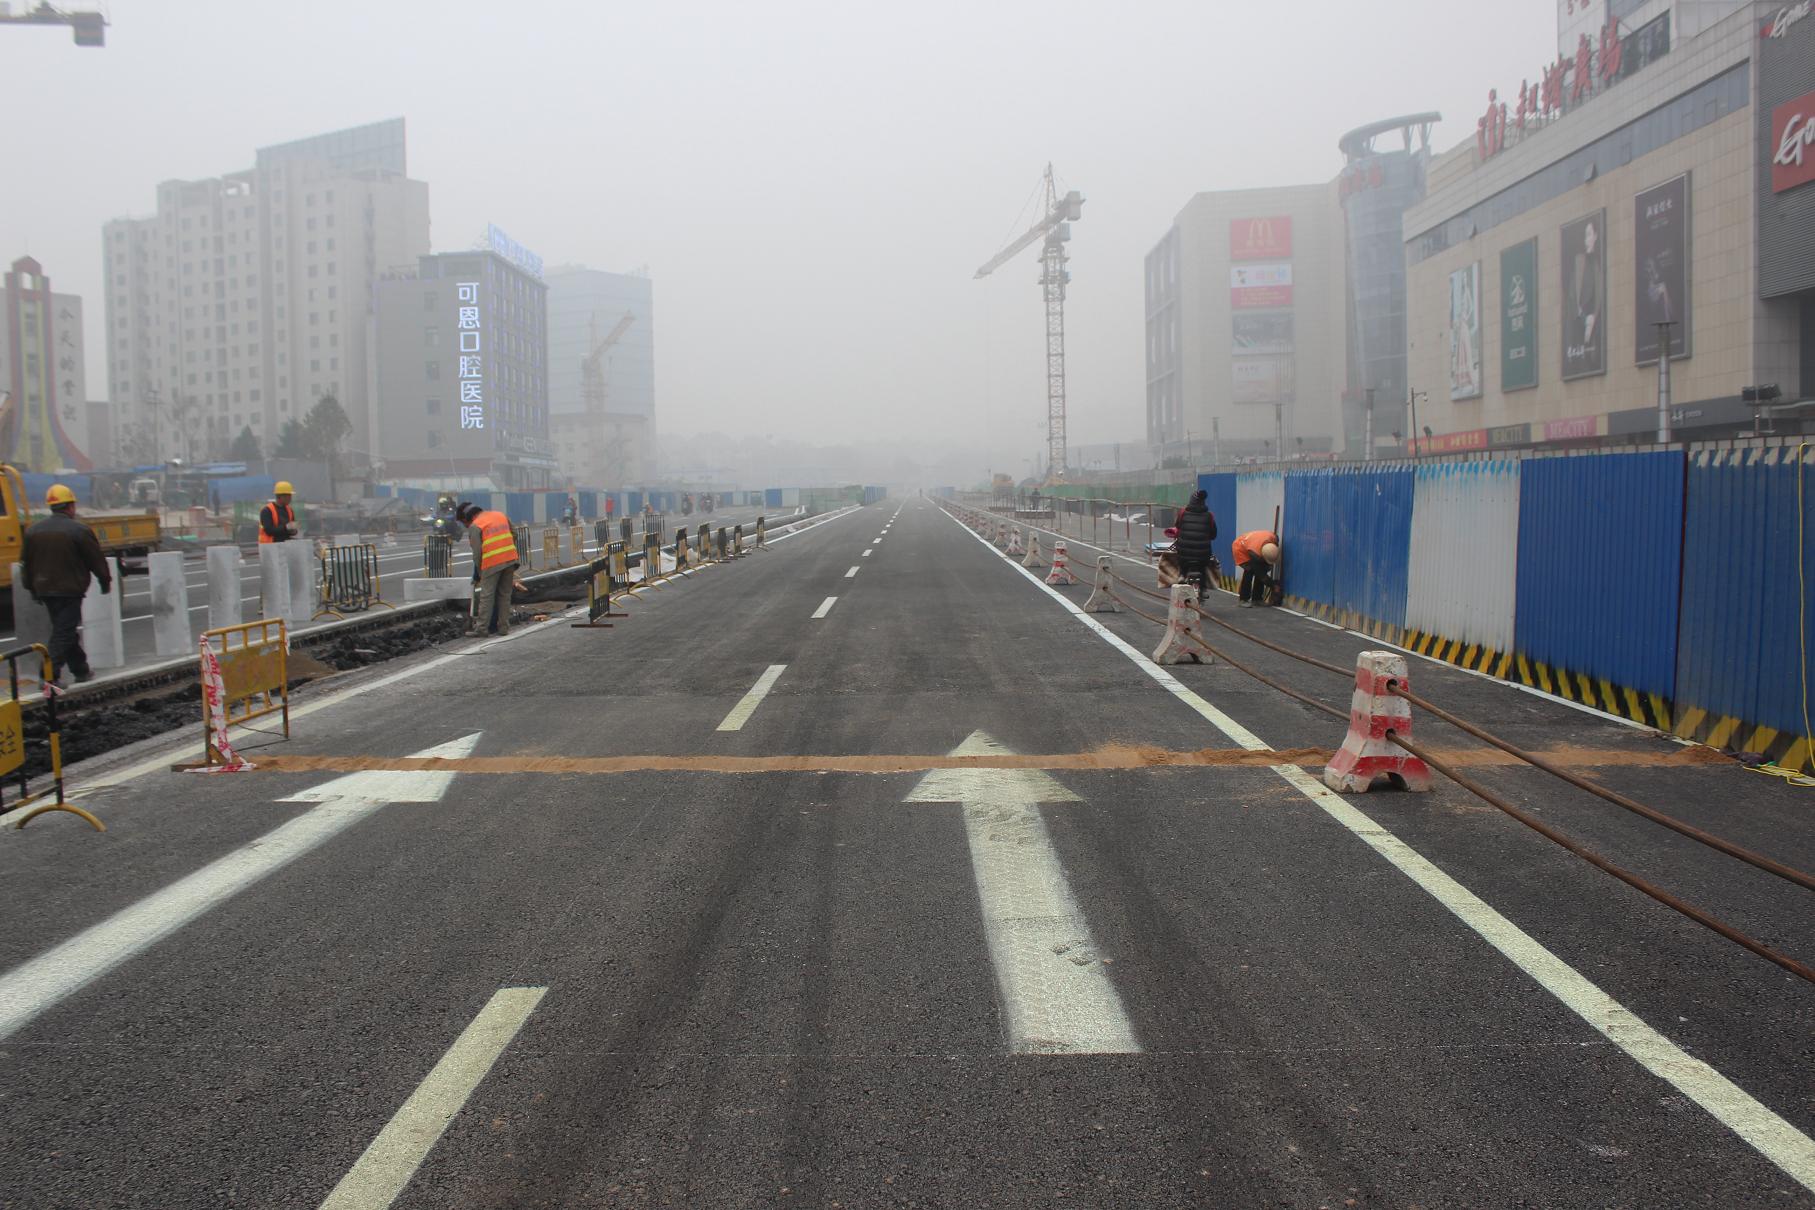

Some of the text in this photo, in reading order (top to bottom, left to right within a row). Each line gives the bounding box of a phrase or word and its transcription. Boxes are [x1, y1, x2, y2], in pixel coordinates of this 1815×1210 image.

[456, 281, 484, 430] 可恩口腔医院
